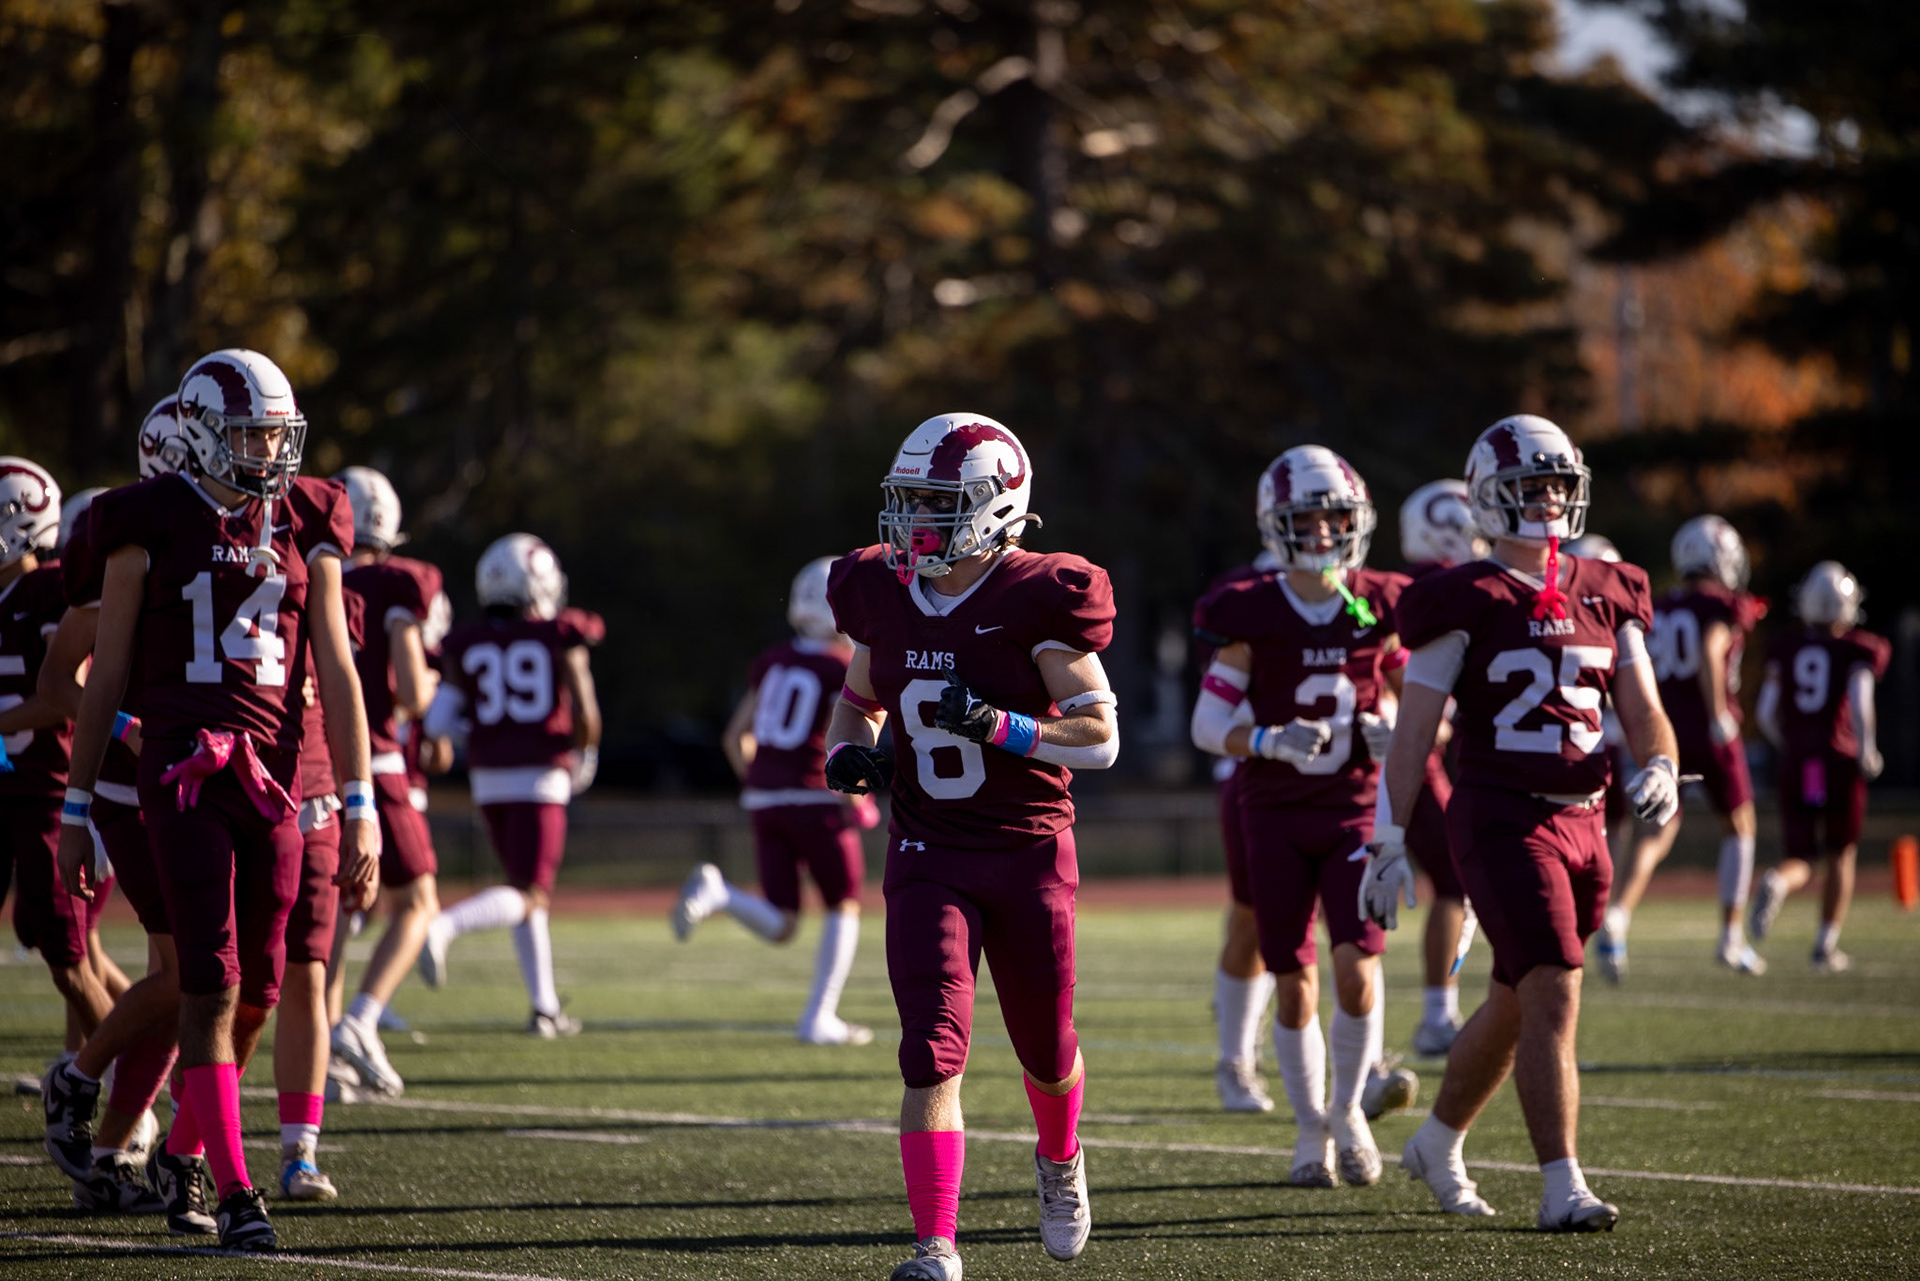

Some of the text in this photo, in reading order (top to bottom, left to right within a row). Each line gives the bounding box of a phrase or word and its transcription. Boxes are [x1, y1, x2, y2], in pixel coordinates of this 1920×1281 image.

[211, 544, 254, 563] RAM
[182, 571, 286, 686] 14
[905, 650, 955, 670] RAMS
[1528, 618, 1576, 637] RAMS
[462, 639, 552, 726] 39
[1486, 645, 1613, 754] 25
[1793, 645, 1830, 713] 9
[900, 679, 986, 800] 8
[1295, 673, 1357, 775] 3
